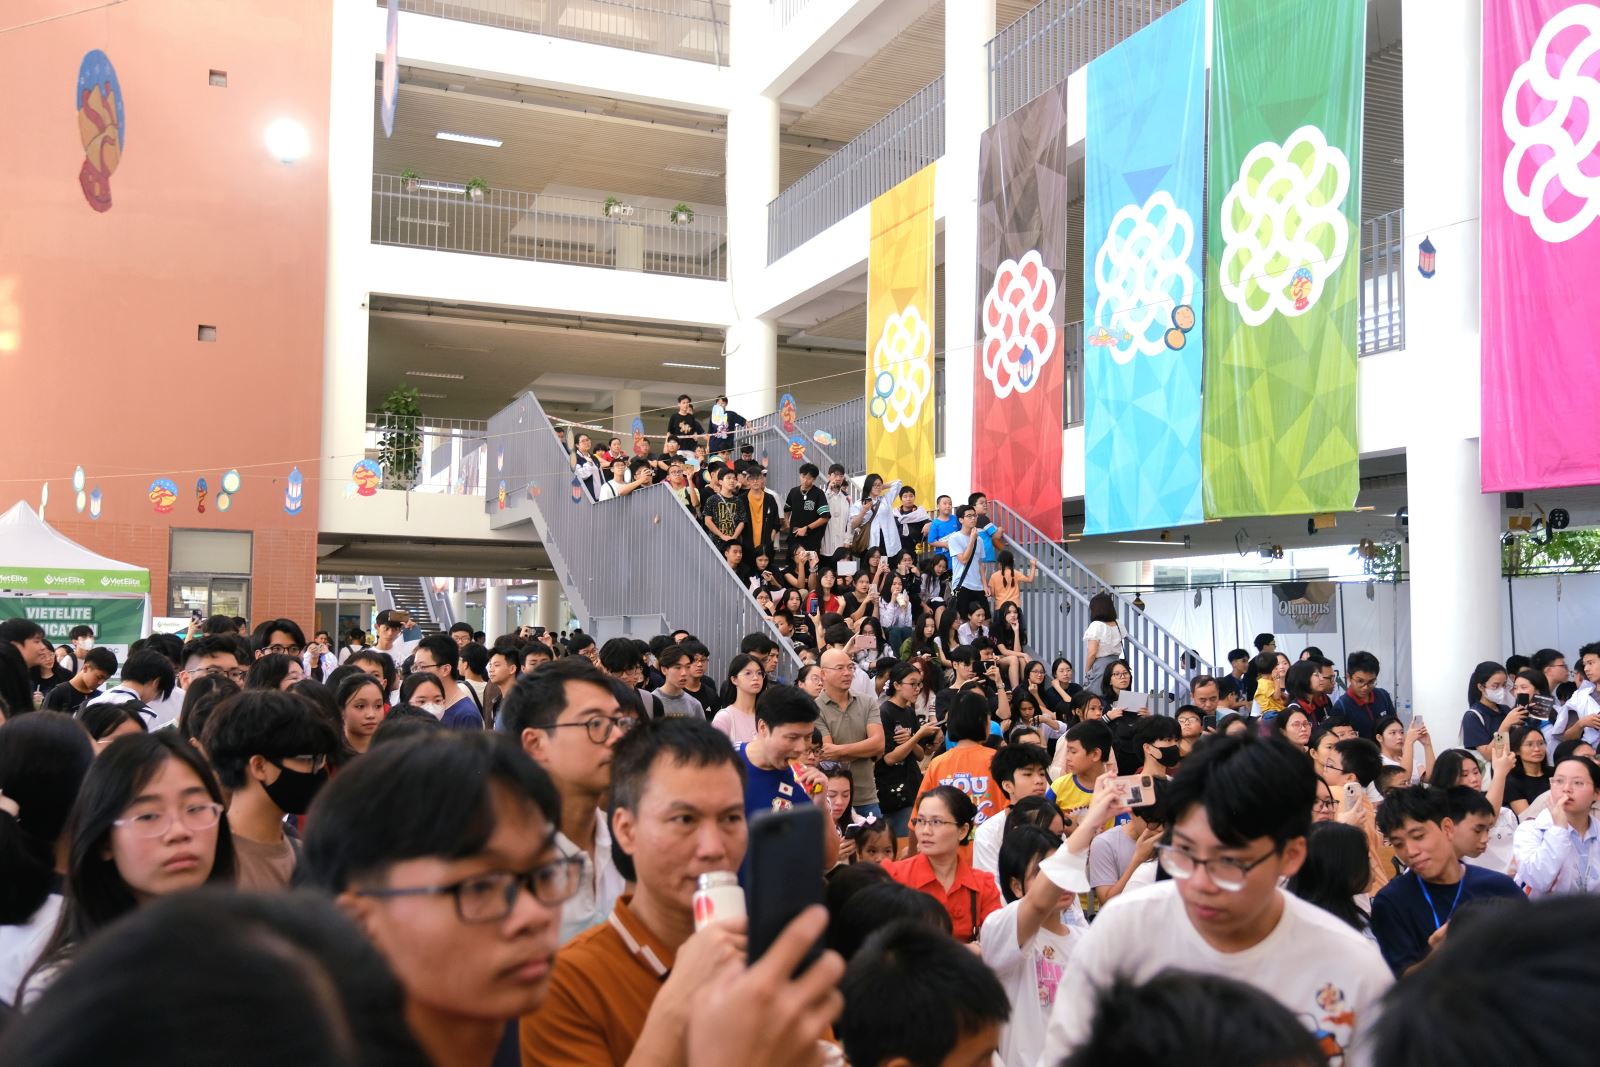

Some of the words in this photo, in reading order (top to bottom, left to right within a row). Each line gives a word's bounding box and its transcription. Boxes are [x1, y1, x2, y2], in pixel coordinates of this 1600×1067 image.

[54, 576, 85, 584] VietElite
[111, 577, 140, 585] VietElite
[26, 607, 92, 619] VIETELITE
[1279, 601, 1329, 618] Olympus
